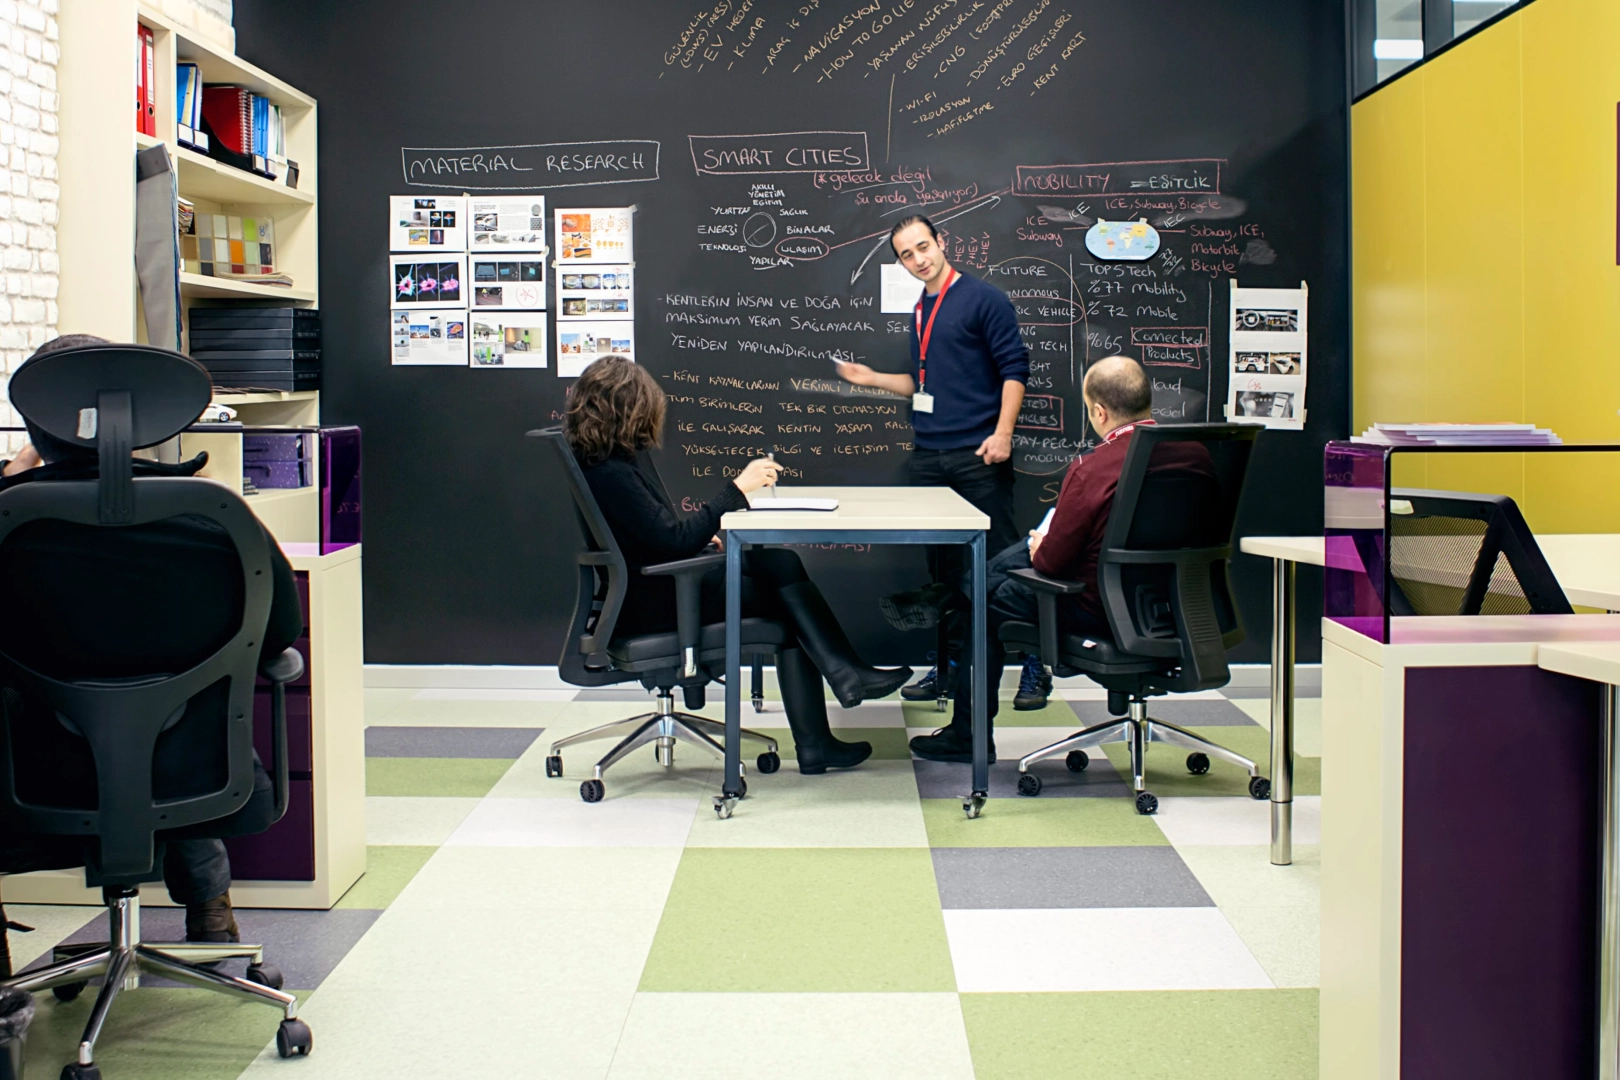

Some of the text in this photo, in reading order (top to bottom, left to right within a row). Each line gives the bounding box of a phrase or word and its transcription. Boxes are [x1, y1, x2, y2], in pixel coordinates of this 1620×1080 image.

[852, 32, 870, 45] TO
[872, 14, 892, 34] GO
[939, 45, 966, 73] CNG
[1001, 63, 1025, 87] EURO
[1033, 64, 1059, 89] KENT
[410, 152, 644, 178] MATERIAL RESEARCH
[703, 146, 862, 169] SMART CITIES
[1024, 173, 1110, 192] MOBILITY
[1026, 216, 1048, 226] ICE
[1016, 228, 1063, 247] Subway
[988, 265, 1048, 276] FUTURE
[1080, 262, 1111, 274] TOP
[1126, 264, 1157, 278] Tech
[1191, 259, 1237, 278] Bicycle
[1132, 281, 1187, 303] Mobility
[780, 298, 799, 308] VE
[1136, 305, 1178, 320] Mobile
[886, 320, 911, 334] ŞEK
[1040, 341, 1068, 352] TECH
[778, 402, 802, 413] TEK
[810, 446, 822, 455] VE
